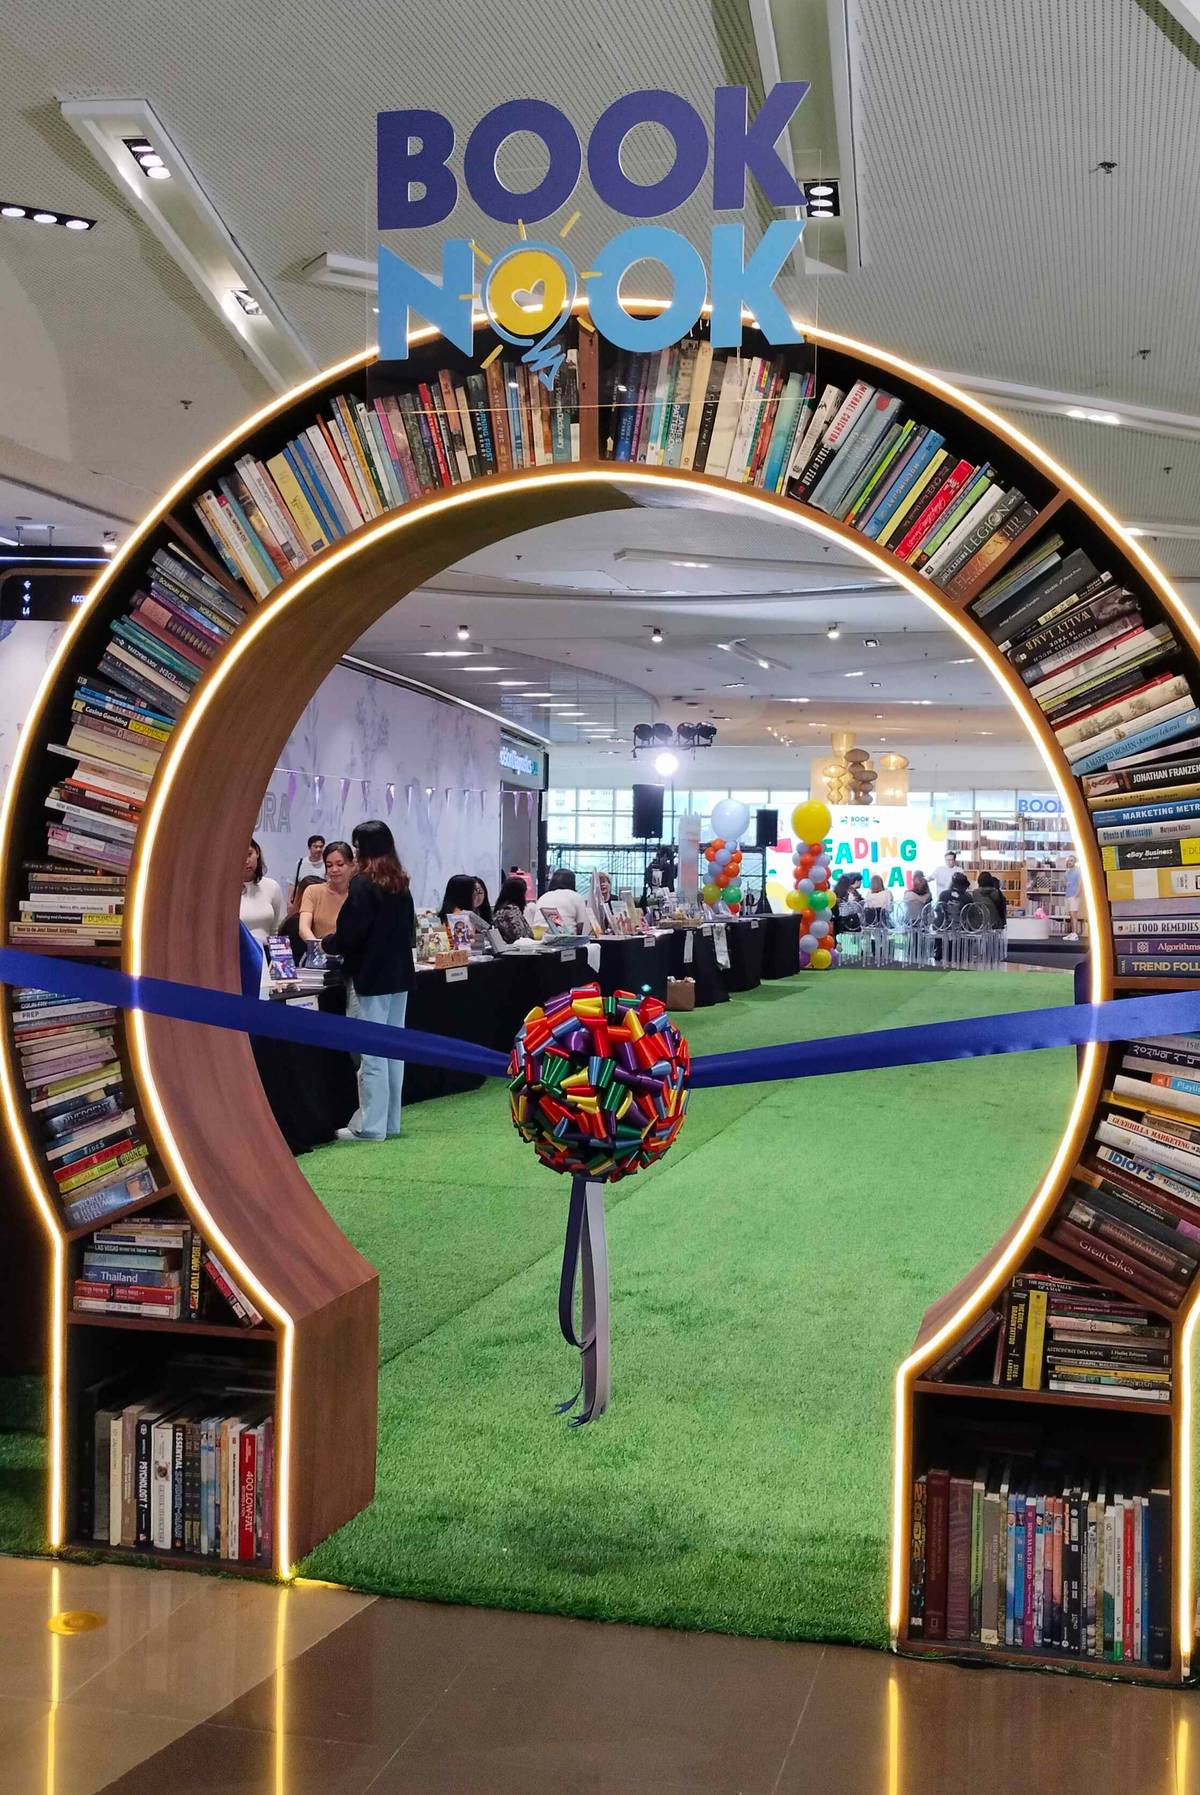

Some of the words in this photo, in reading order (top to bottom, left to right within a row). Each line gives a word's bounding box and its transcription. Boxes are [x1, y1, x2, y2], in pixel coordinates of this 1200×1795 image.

[377, 80, 811, 230] BOOK
[377, 218, 807, 361] NOOK
[845, 383, 867, 413] MICHAEL
[476, 401, 490, 437] MORNING
[483, 437, 494, 462] FROST
[827, 412, 851, 444] CRICHTON
[814, 443, 832, 464] STATE
[801, 468, 816, 486] FEAR
[962, 501, 1012, 555] LEGION
[1054, 609, 1091, 634] WALLY
[1024, 630, 1054, 651] LAMB
[1071, 627, 1092, 641] KNOW
[1031, 648, 1053, 663] MUCH
[1053, 639, 1070, 652] THIS
[158, 666, 177, 682] EDEN
[84, 705, 103, 717] Casino
[101, 712, 128, 727] Gambling
[1131, 767, 1168, 785] JONATHAN
[1168, 762, 1200, 778] FRANZEN
[1122, 805, 1174, 821] MARKETING
[1176, 802, 1200, 813] METR
[1102, 830, 1119, 840] Ghosts
[1125, 826, 1153, 839] Mississippi
[823, 836, 917, 864] EADING
[1125, 851, 1143, 859] eBay
[1144, 847, 1173, 856] Business
[1137, 923, 1158, 932] FOOD
[1161, 922, 1199, 932] REMEDIES
[1157, 942, 1200, 952] Algorithms
[1131, 961, 1170, 971] TREND
[1173, 962, 1200, 971] FOLL
[21, 1010, 40, 1019] PREP
[1111, 1116, 1150, 1135] GUERRILLA
[1150, 1130, 1190, 1150] MARKETING
[1108, 1150, 1157, 1181] IDIOT'S
[100, 1271, 138, 1282] Thailand
[190, 1271, 200, 1289] TWO
[175, 1432, 183, 1469] ESSENTIAL
[138, 1460, 147, 1501] PSYCHOLOGY
[245, 1470, 253, 1491] 400
[174, 1470, 183, 1538] SPIDER-MAN
[244, 1492, 253, 1532] LOW-FAT
